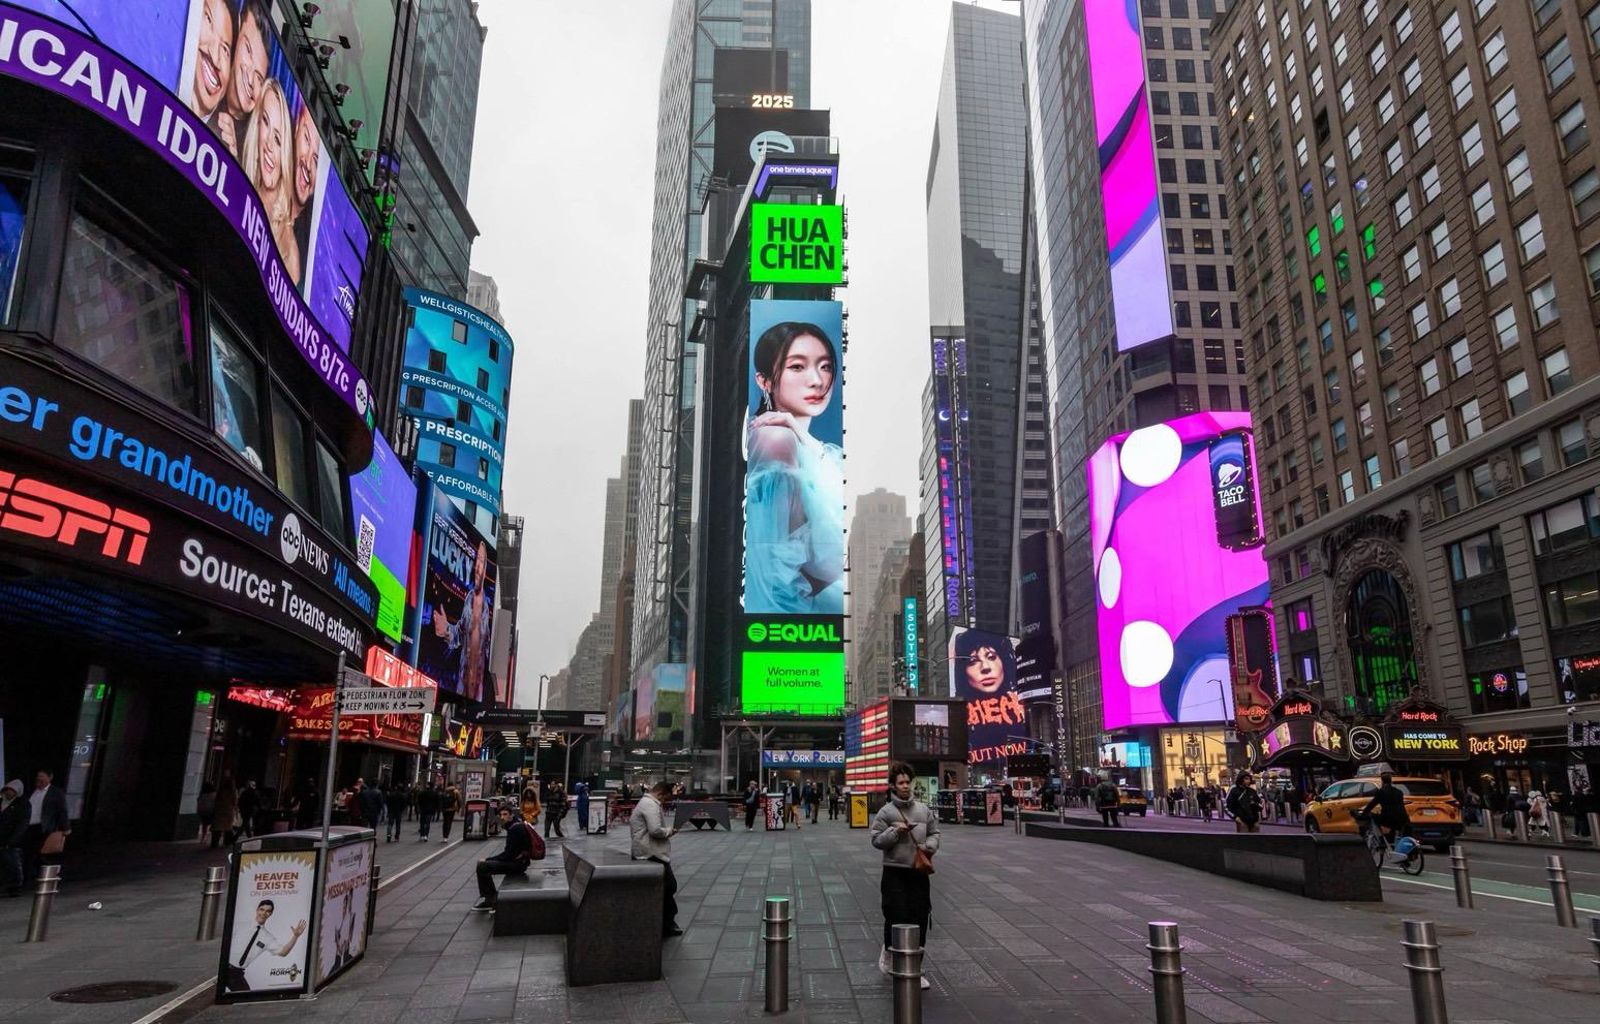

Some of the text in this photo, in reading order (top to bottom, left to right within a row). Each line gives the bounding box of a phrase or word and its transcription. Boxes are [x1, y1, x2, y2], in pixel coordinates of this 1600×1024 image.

[752, 94, 794, 108] 2025
[784, 166, 805, 174] times
[806, 167, 832, 175] square
[0, 19, 349, 392] ICAN IDOL NEW SUNDAYS 8/7c
[768, 217, 830, 243] HUA
[760, 244, 835, 271] CHEN
[412, 373, 475, 399] PRESCRIPTION
[475, 395, 497, 413] ACCESS
[0, 386, 59, 431] er
[69, 416, 274, 536] grandmother
[437, 474, 493, 504] AFFORDABLE
[1217, 485, 1244, 499] TACO
[1220, 496, 1245, 508] BELL
[431, 525, 474, 586] LUCKY
[282, 525, 299, 549] abc
[299, 533, 331, 576] NEWS
[348, 574, 371, 616] means
[180, 539, 276, 607] Source:
[280, 580, 326, 633] Texans
[326, 617, 356, 652] extend
[769, 624, 841, 643] EQUAL
[768, 666, 820, 676] Women at
[766, 679, 823, 688] full volume.
[346, 690, 426, 700] PEDESTRIAN FLOW ZONE
[1054, 677, 1065, 718] SQUARE
[345, 702, 390, 711] KEEP MOVING
[1284, 702, 1312, 716] Hard Rock
[1401, 712, 1437, 722] Hard Rock
[295, 719, 354, 730] BAKESOP
[996, 741, 1027, 759] NOW
[1394, 739, 1459, 750] NEW YORK
[1468, 735, 1527, 755] Rock Shop
[813, 750, 843, 763] POLICE
[254, 872, 299, 881] HEAVEN
[256, 880, 295, 890] EXISTS
